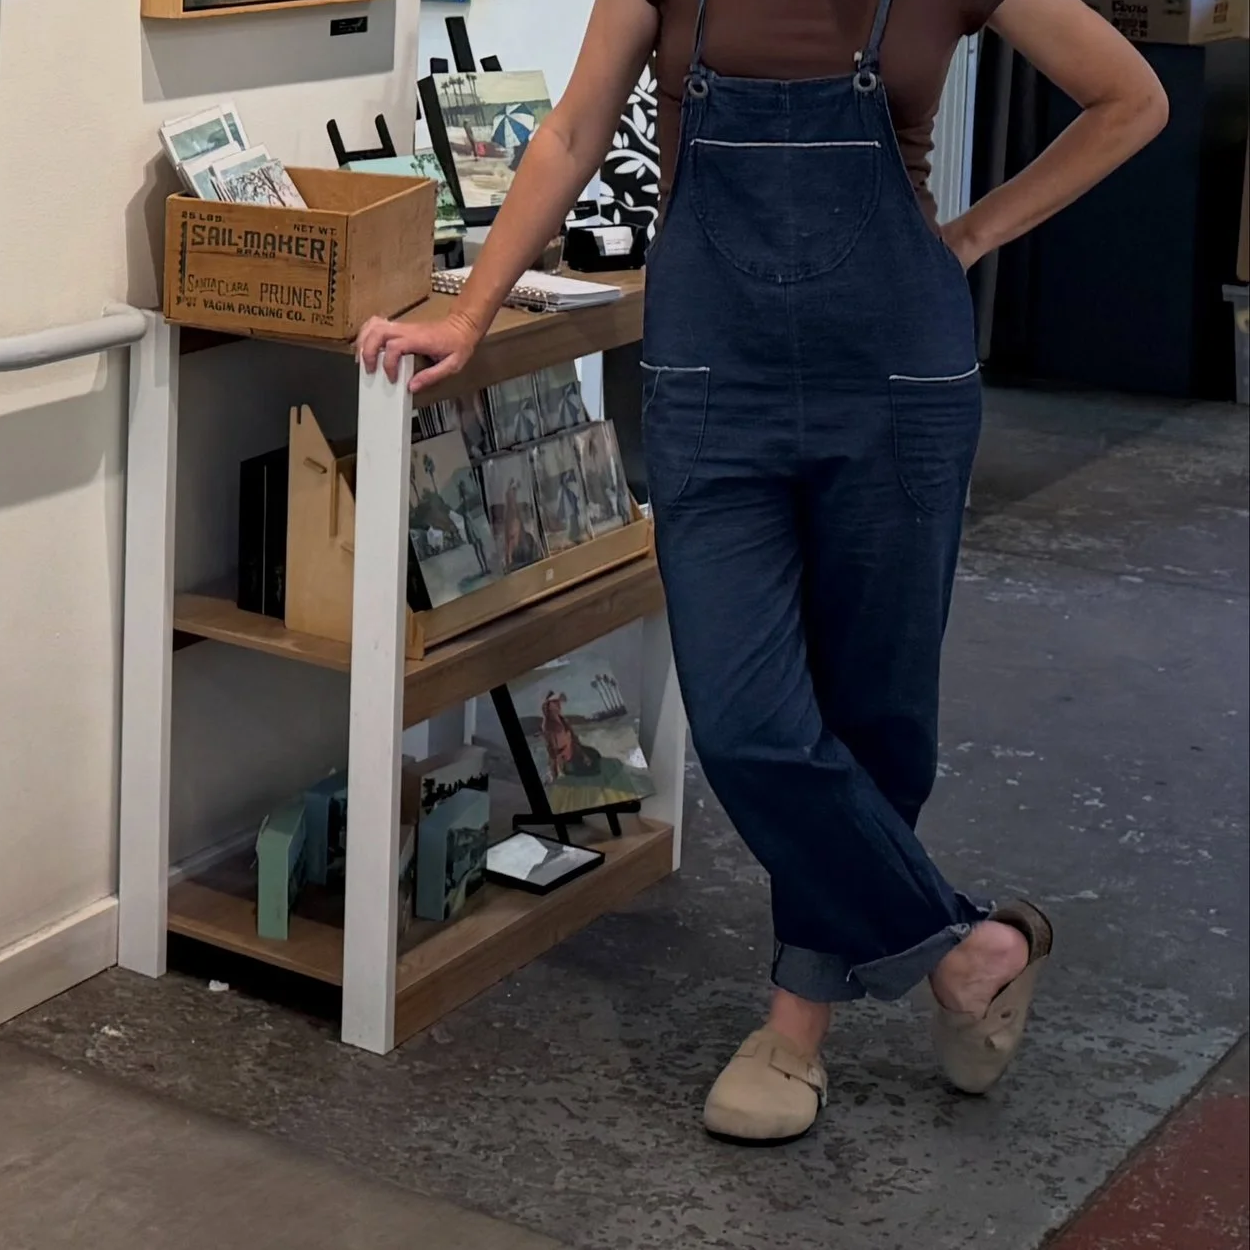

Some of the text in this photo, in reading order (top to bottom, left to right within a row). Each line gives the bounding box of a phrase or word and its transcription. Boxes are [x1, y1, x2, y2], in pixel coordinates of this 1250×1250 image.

[293, 224, 314, 234] NET
[260, 282, 323, 310] PRUNES
[203, 298, 235, 312] VAGIM
[238, 303, 283, 319] PACKING
[286, 310, 306, 322] CO.
